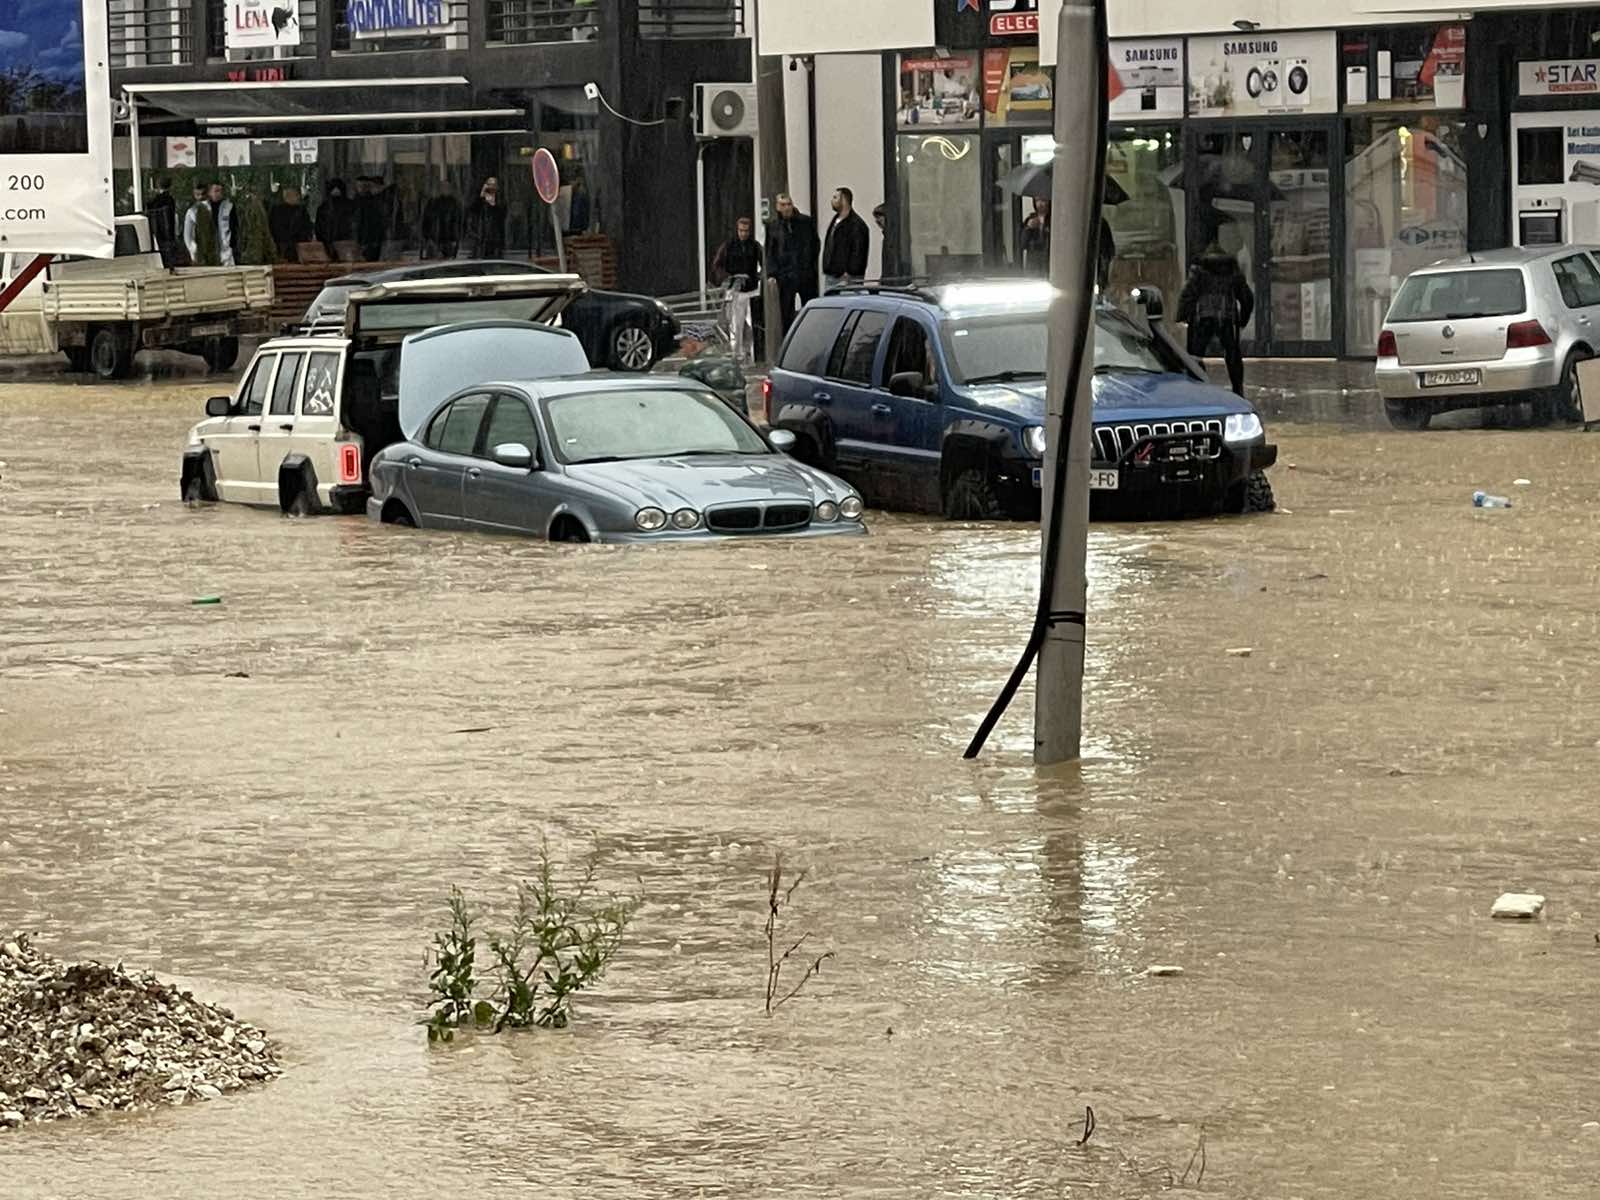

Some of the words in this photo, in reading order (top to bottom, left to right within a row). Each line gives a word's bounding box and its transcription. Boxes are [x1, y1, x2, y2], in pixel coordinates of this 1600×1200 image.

[235, 4, 269, 30] LENA
[1125, 47, 1178, 63] SAMSUNG
[1223, 40, 1278, 56] SAMSUNG
[1548, 64, 1596, 83] STAR
[8, 174, 45, 191] 200
